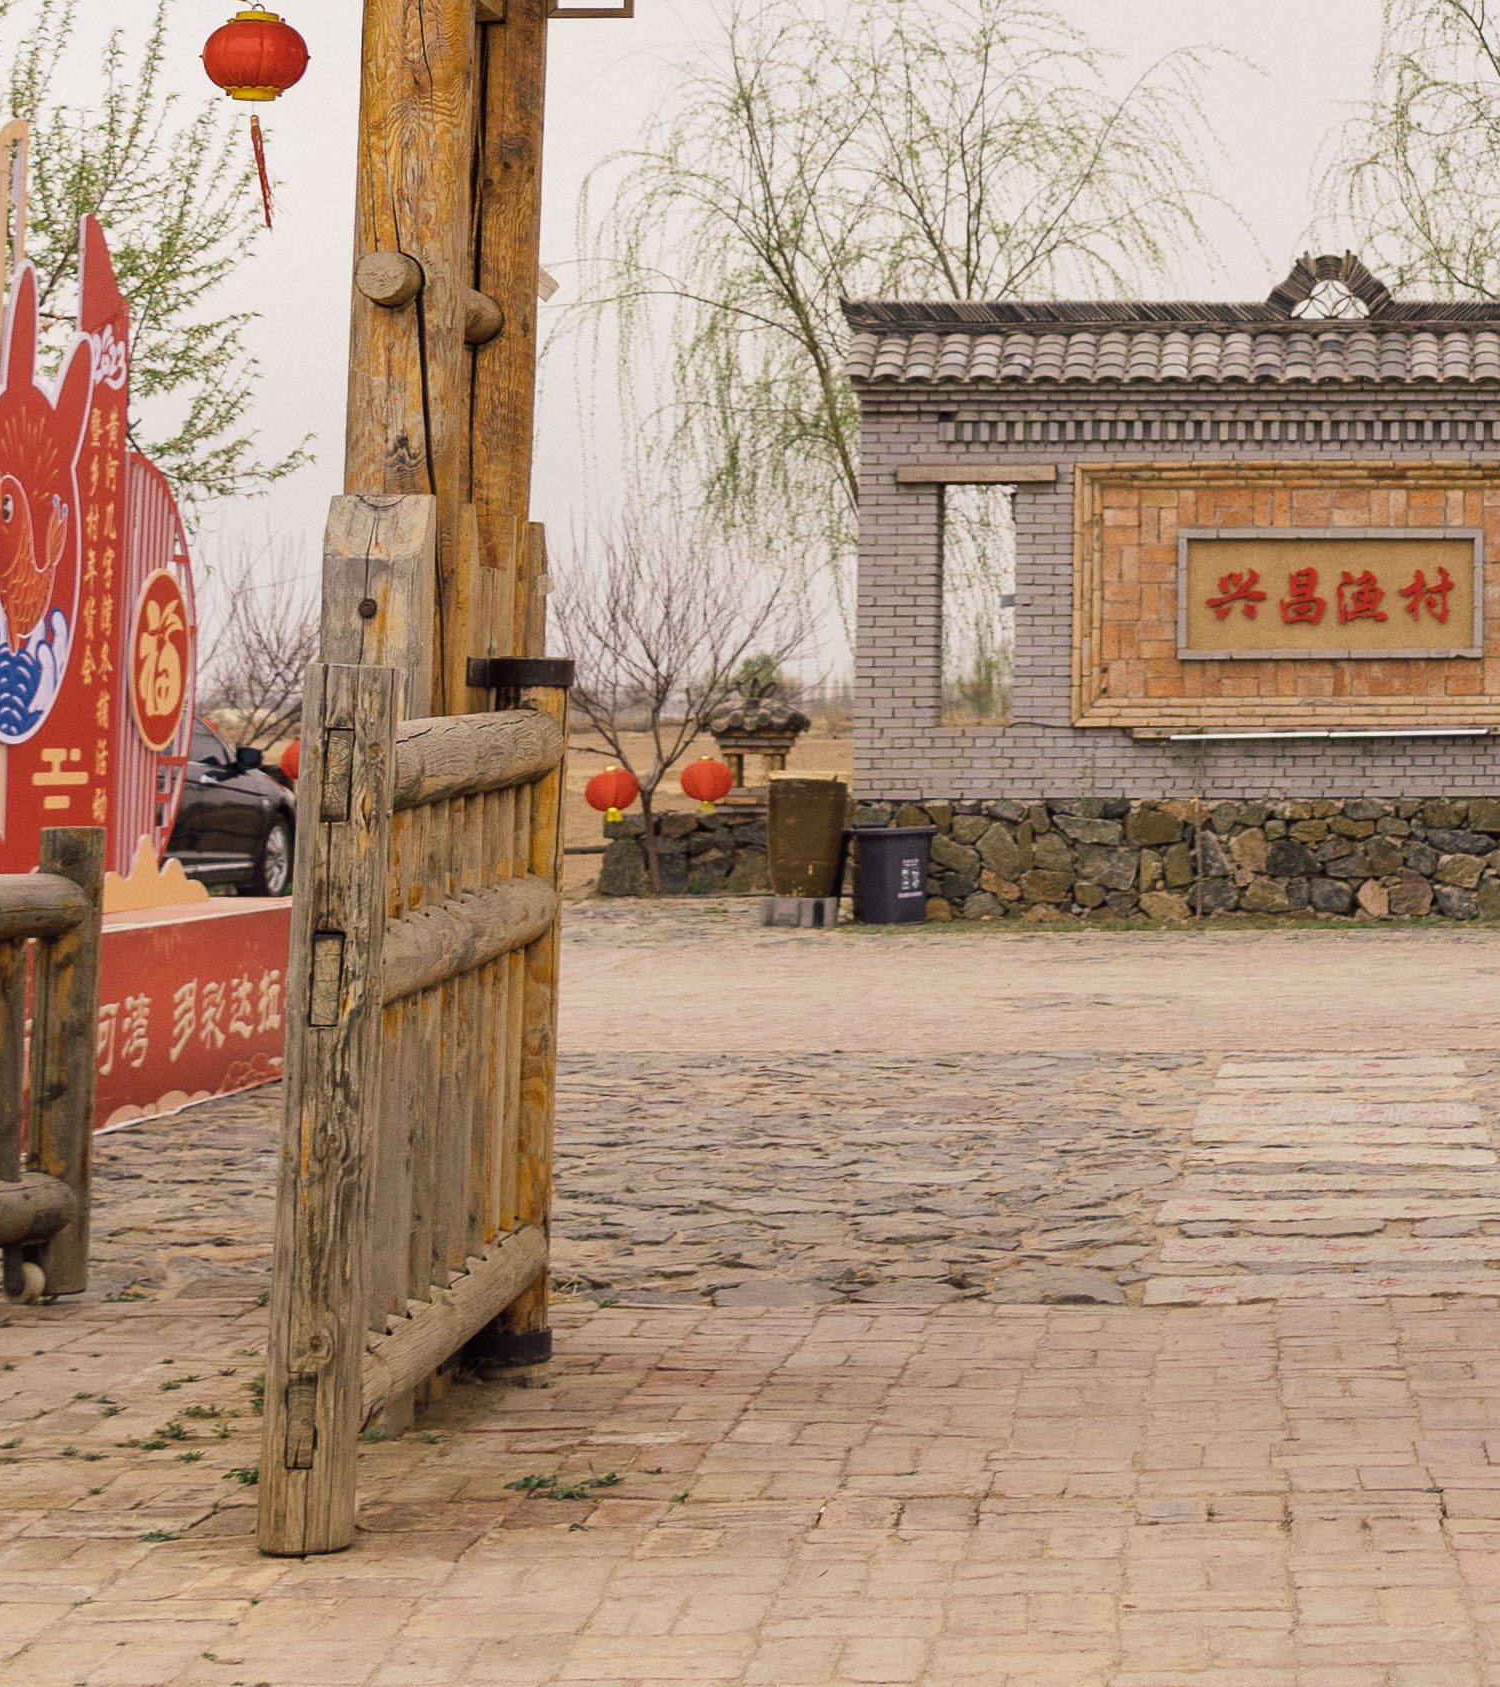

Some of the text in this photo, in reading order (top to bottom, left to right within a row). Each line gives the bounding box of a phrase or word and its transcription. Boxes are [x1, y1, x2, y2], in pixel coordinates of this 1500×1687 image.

[1205, 566, 1455, 625] 兴昌渔村
[139, 599, 185, 717] 福
[169, 969, 286, 1063] 多彩达拉
